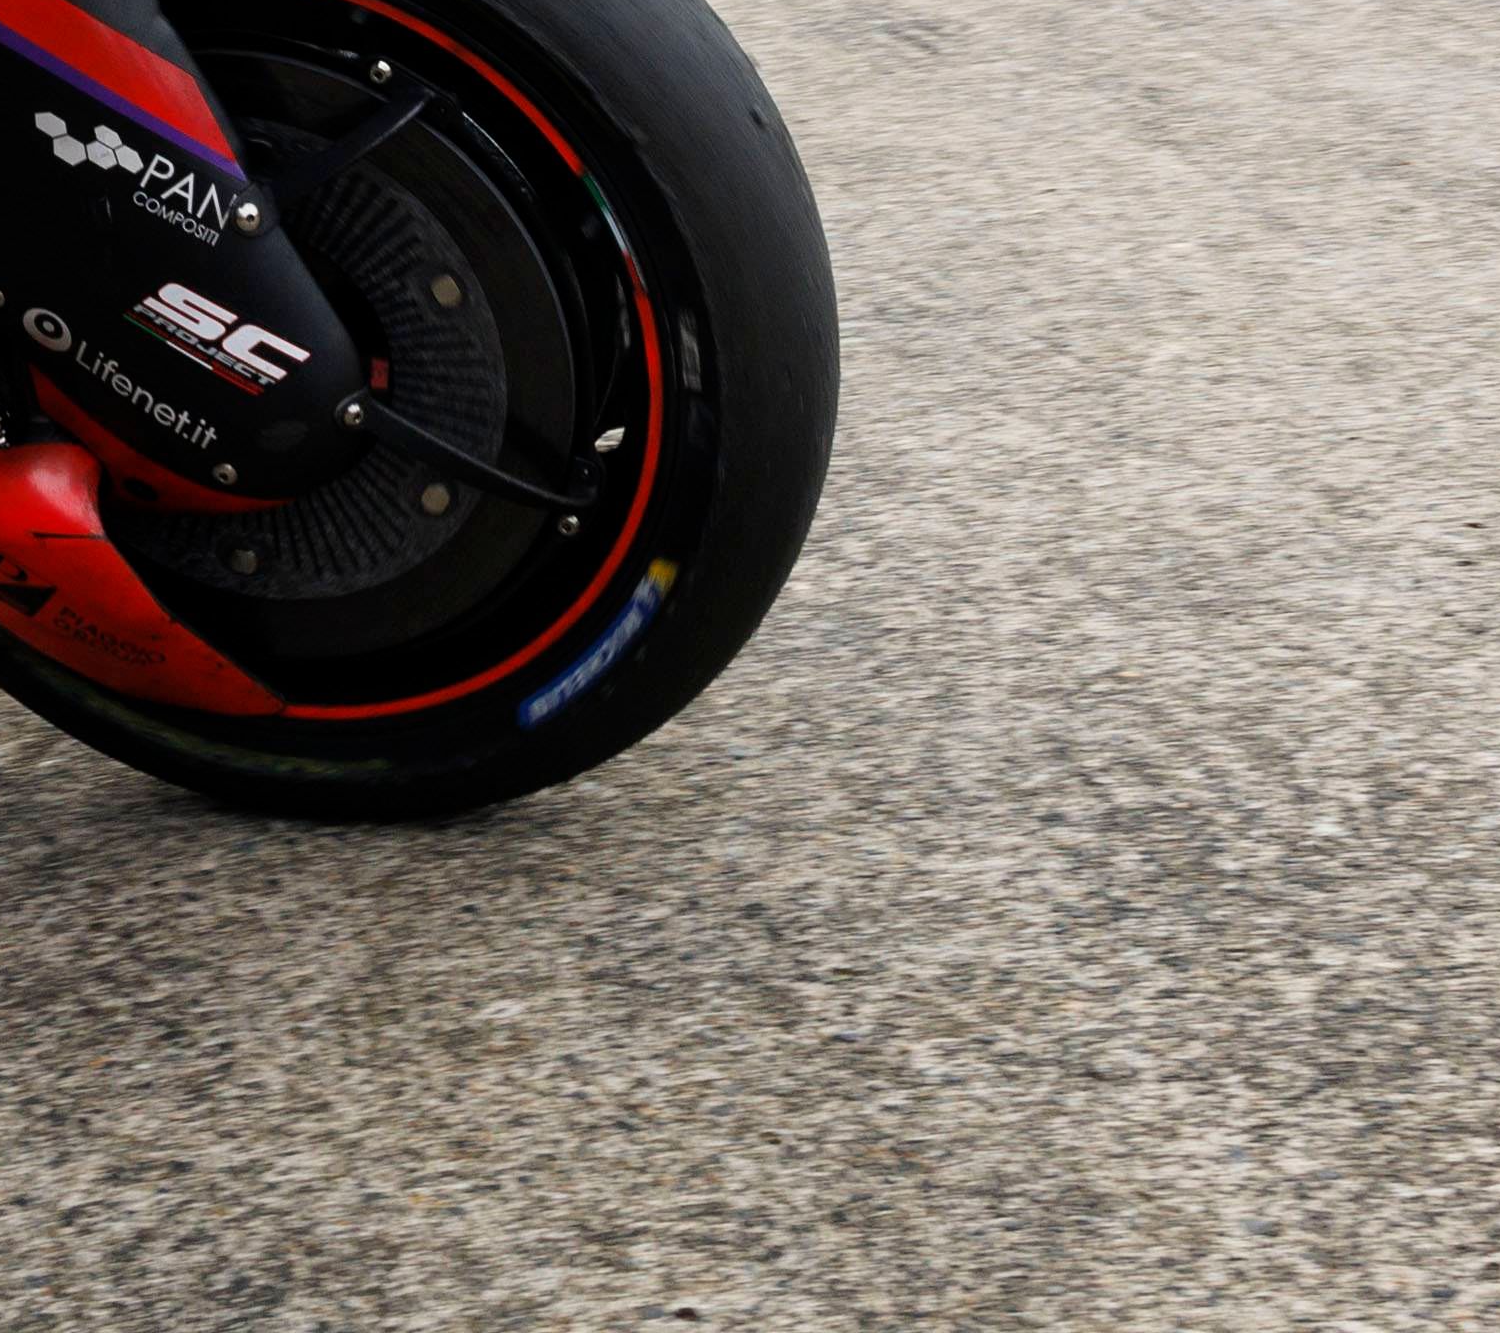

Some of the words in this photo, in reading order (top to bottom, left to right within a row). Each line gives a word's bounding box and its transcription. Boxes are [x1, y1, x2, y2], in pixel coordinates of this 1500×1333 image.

[131, 190, 222, 248] COMPOSITI
[138, 152, 238, 231] PAN
[140, 281, 313, 383] SC
[73, 338, 219, 451] Lifenet.it
